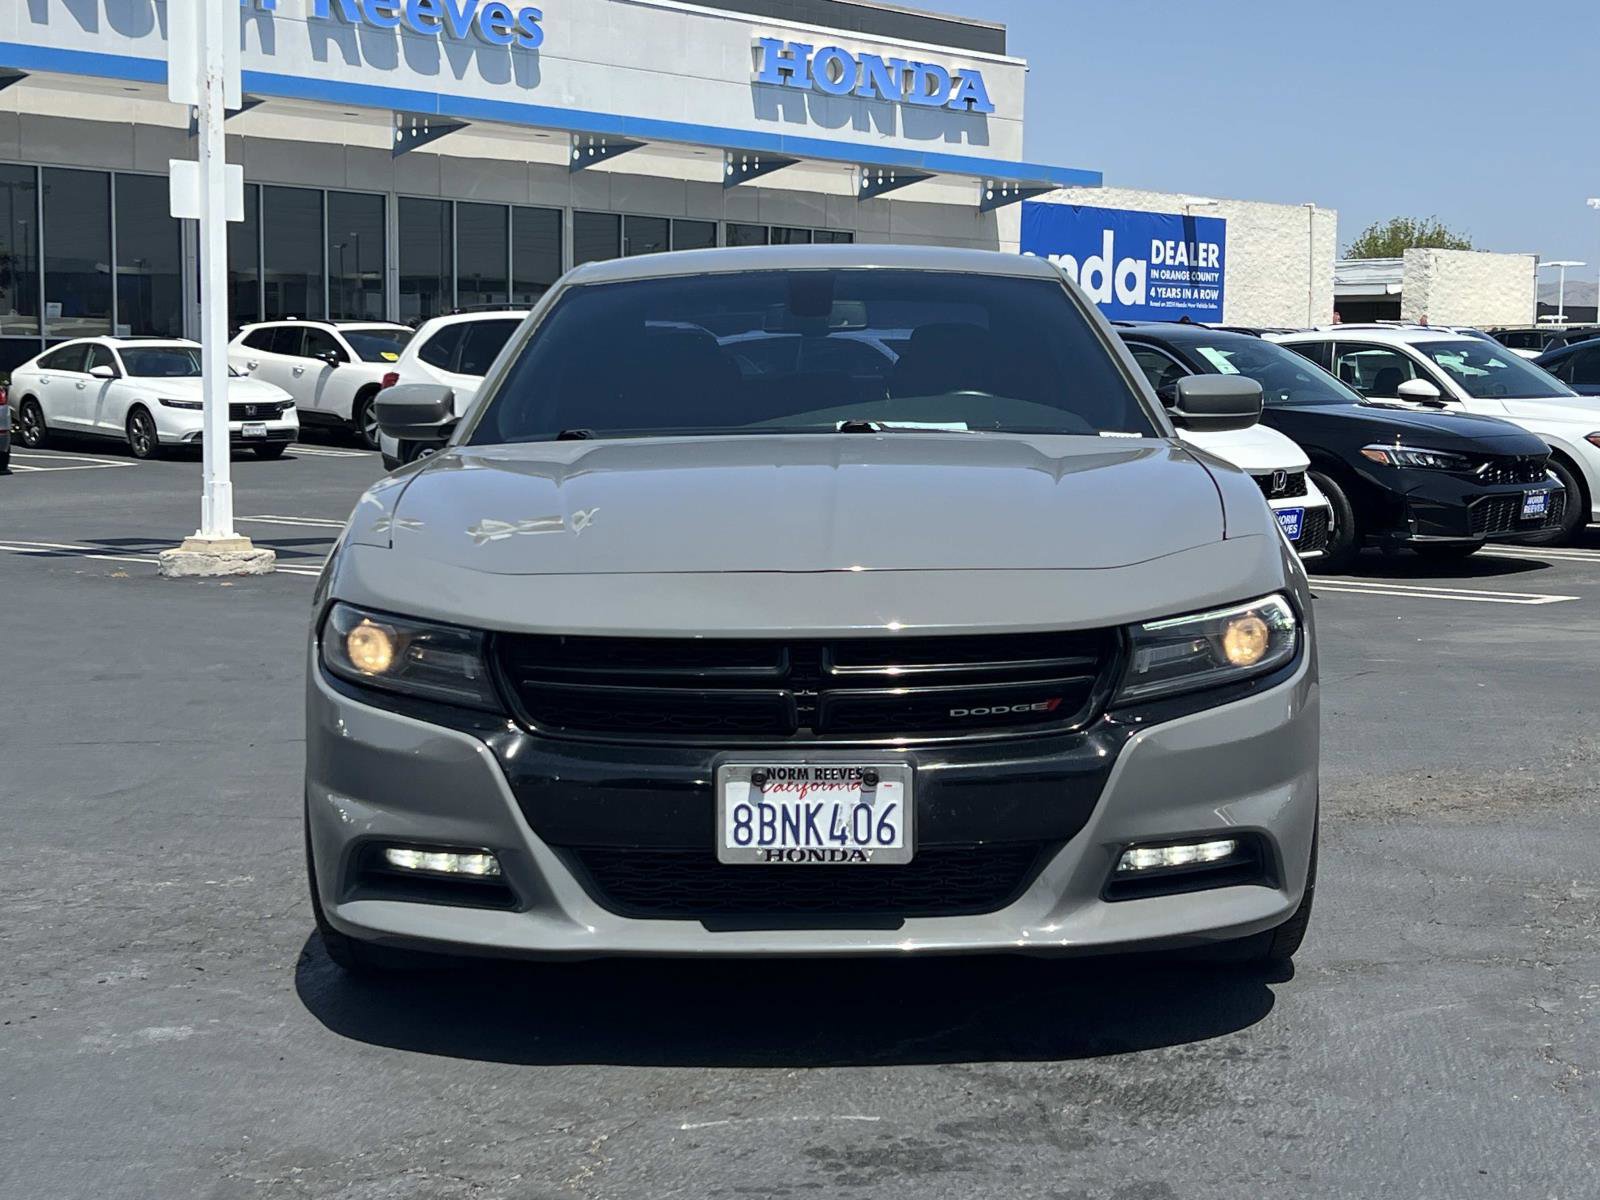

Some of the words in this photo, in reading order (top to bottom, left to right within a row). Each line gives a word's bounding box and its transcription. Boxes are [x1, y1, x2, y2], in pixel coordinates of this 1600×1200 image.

[752, 37, 995, 113] HONDA
[1151, 239, 1219, 268] DEALER
[1150, 269, 1159, 279] IN
[1160, 270, 1190, 281] ORANGE
[1191, 271, 1219, 282] COUNTY
[1150, 287, 1156, 298] 4
[1157, 287, 1181, 298] YEARS
[1182, 288, 1192, 298] IN
[1192, 289, 1199, 299] A
[1200, 289, 1219, 300] ROW
[1279, 514, 1297, 525] ORM
[949, 702, 1049, 717] DODGE
[767, 767, 809, 780] NORM
[815, 767, 863, 780] REEVES
[733, 803, 897, 846] 8BNK406
[765, 849, 867, 862] HONDA
